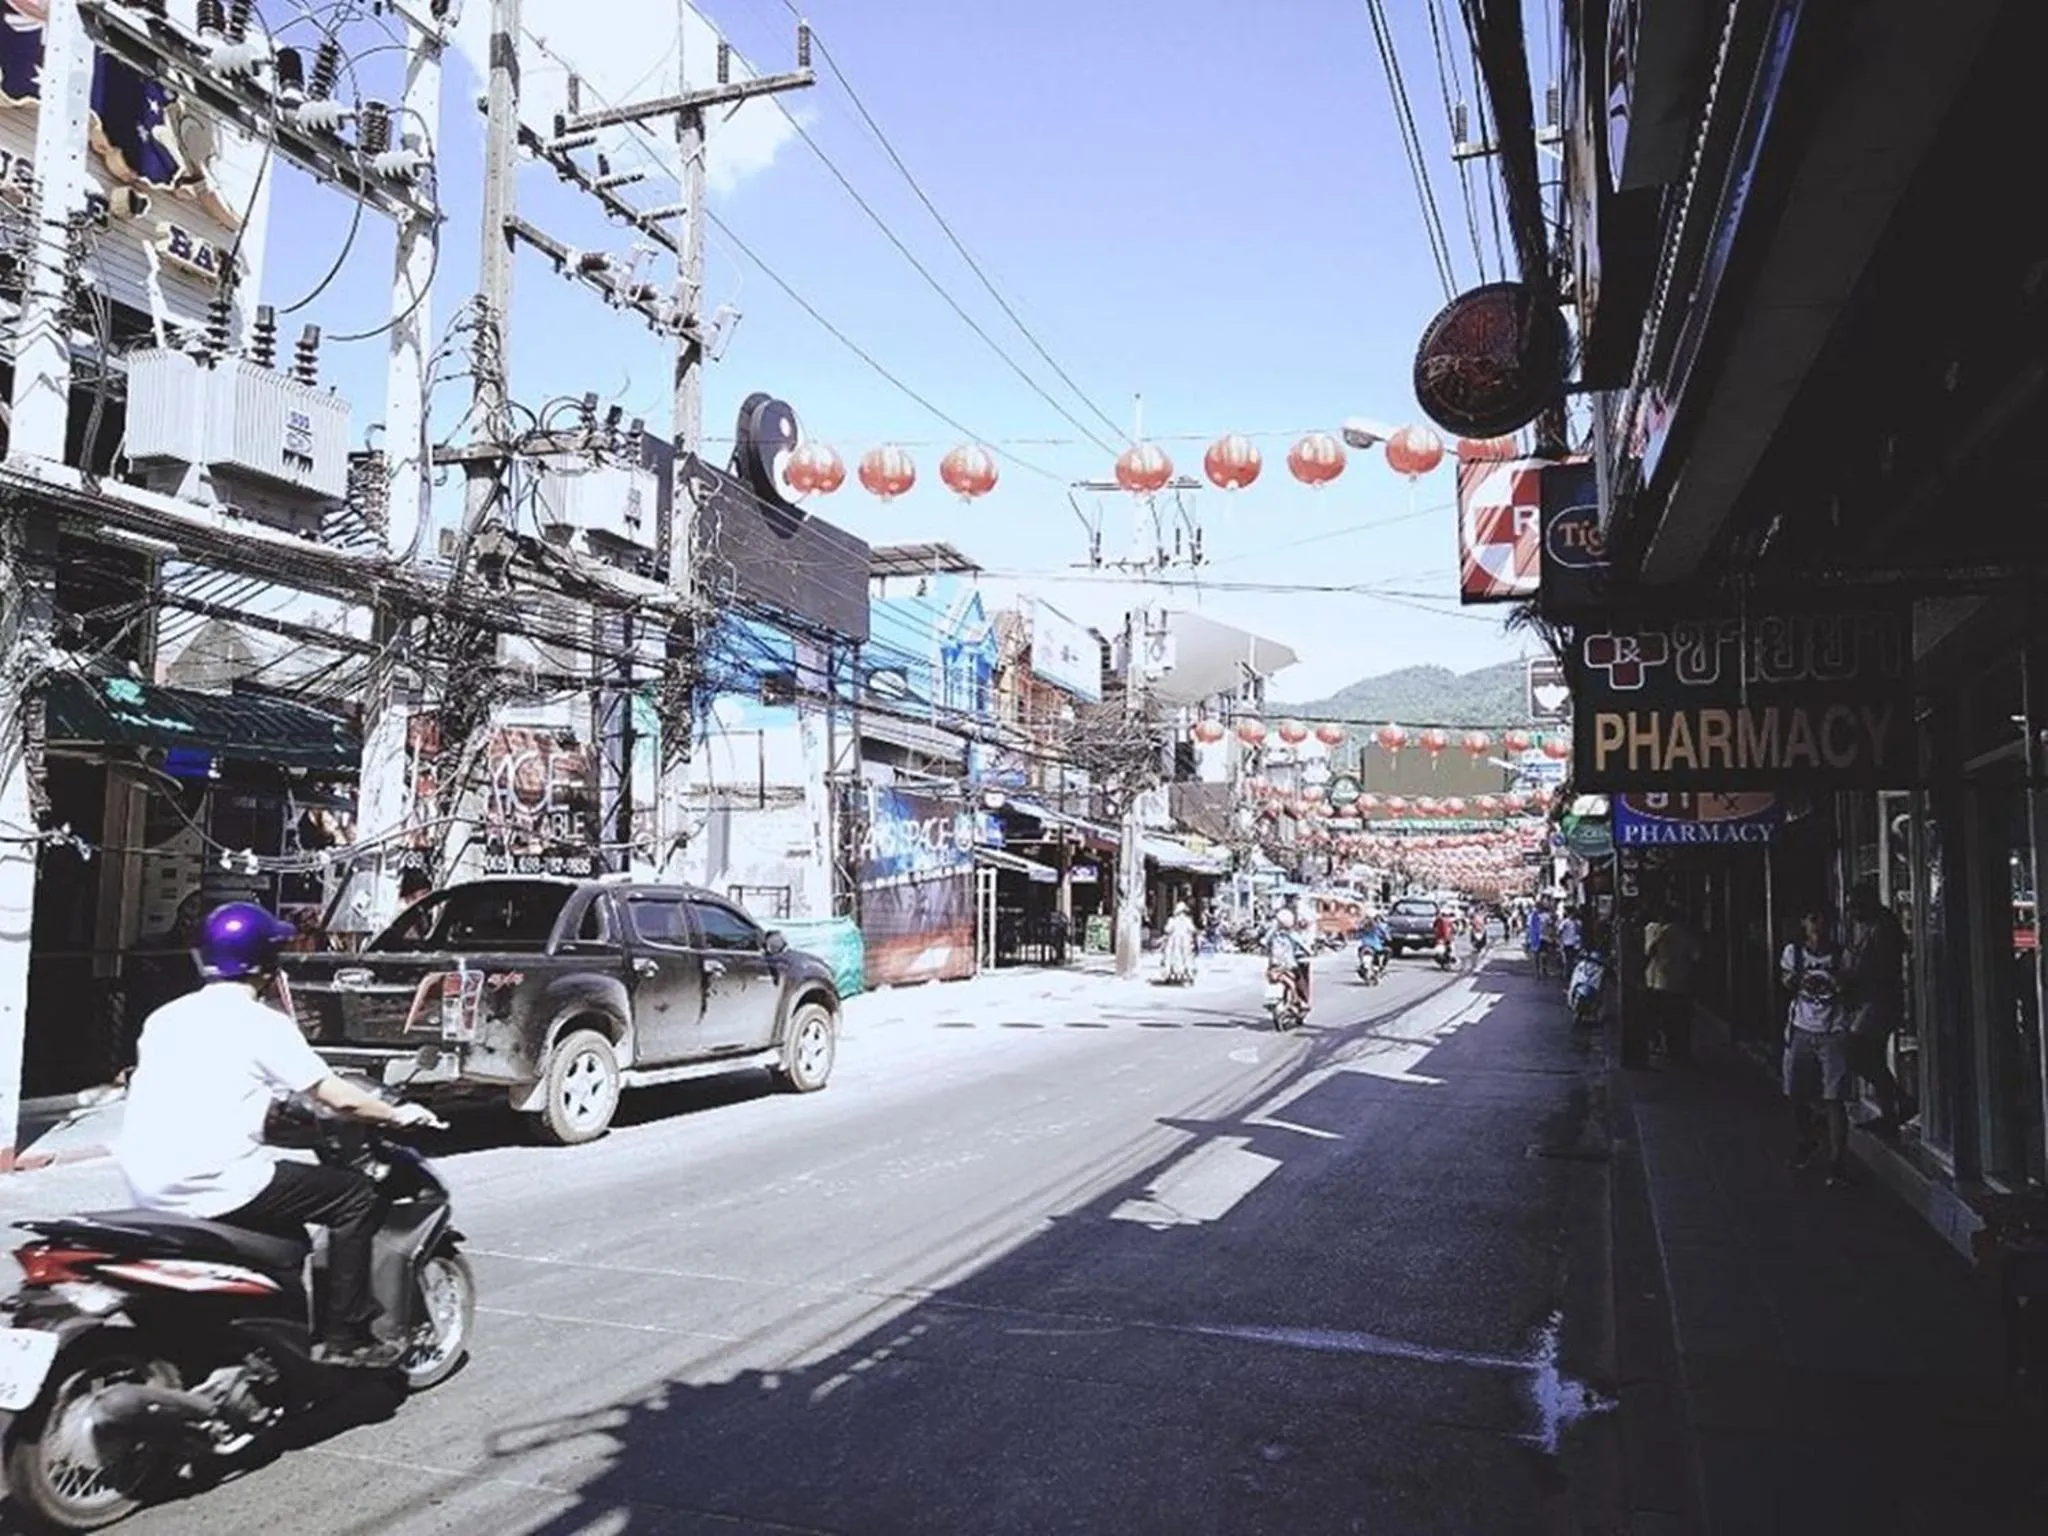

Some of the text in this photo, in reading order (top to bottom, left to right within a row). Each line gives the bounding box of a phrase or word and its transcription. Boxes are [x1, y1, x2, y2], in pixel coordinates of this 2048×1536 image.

[166, 223, 220, 274] BA
[1594, 704, 1893, 772] PHARMACY
[1624, 822, 1774, 844] PHARMACY
